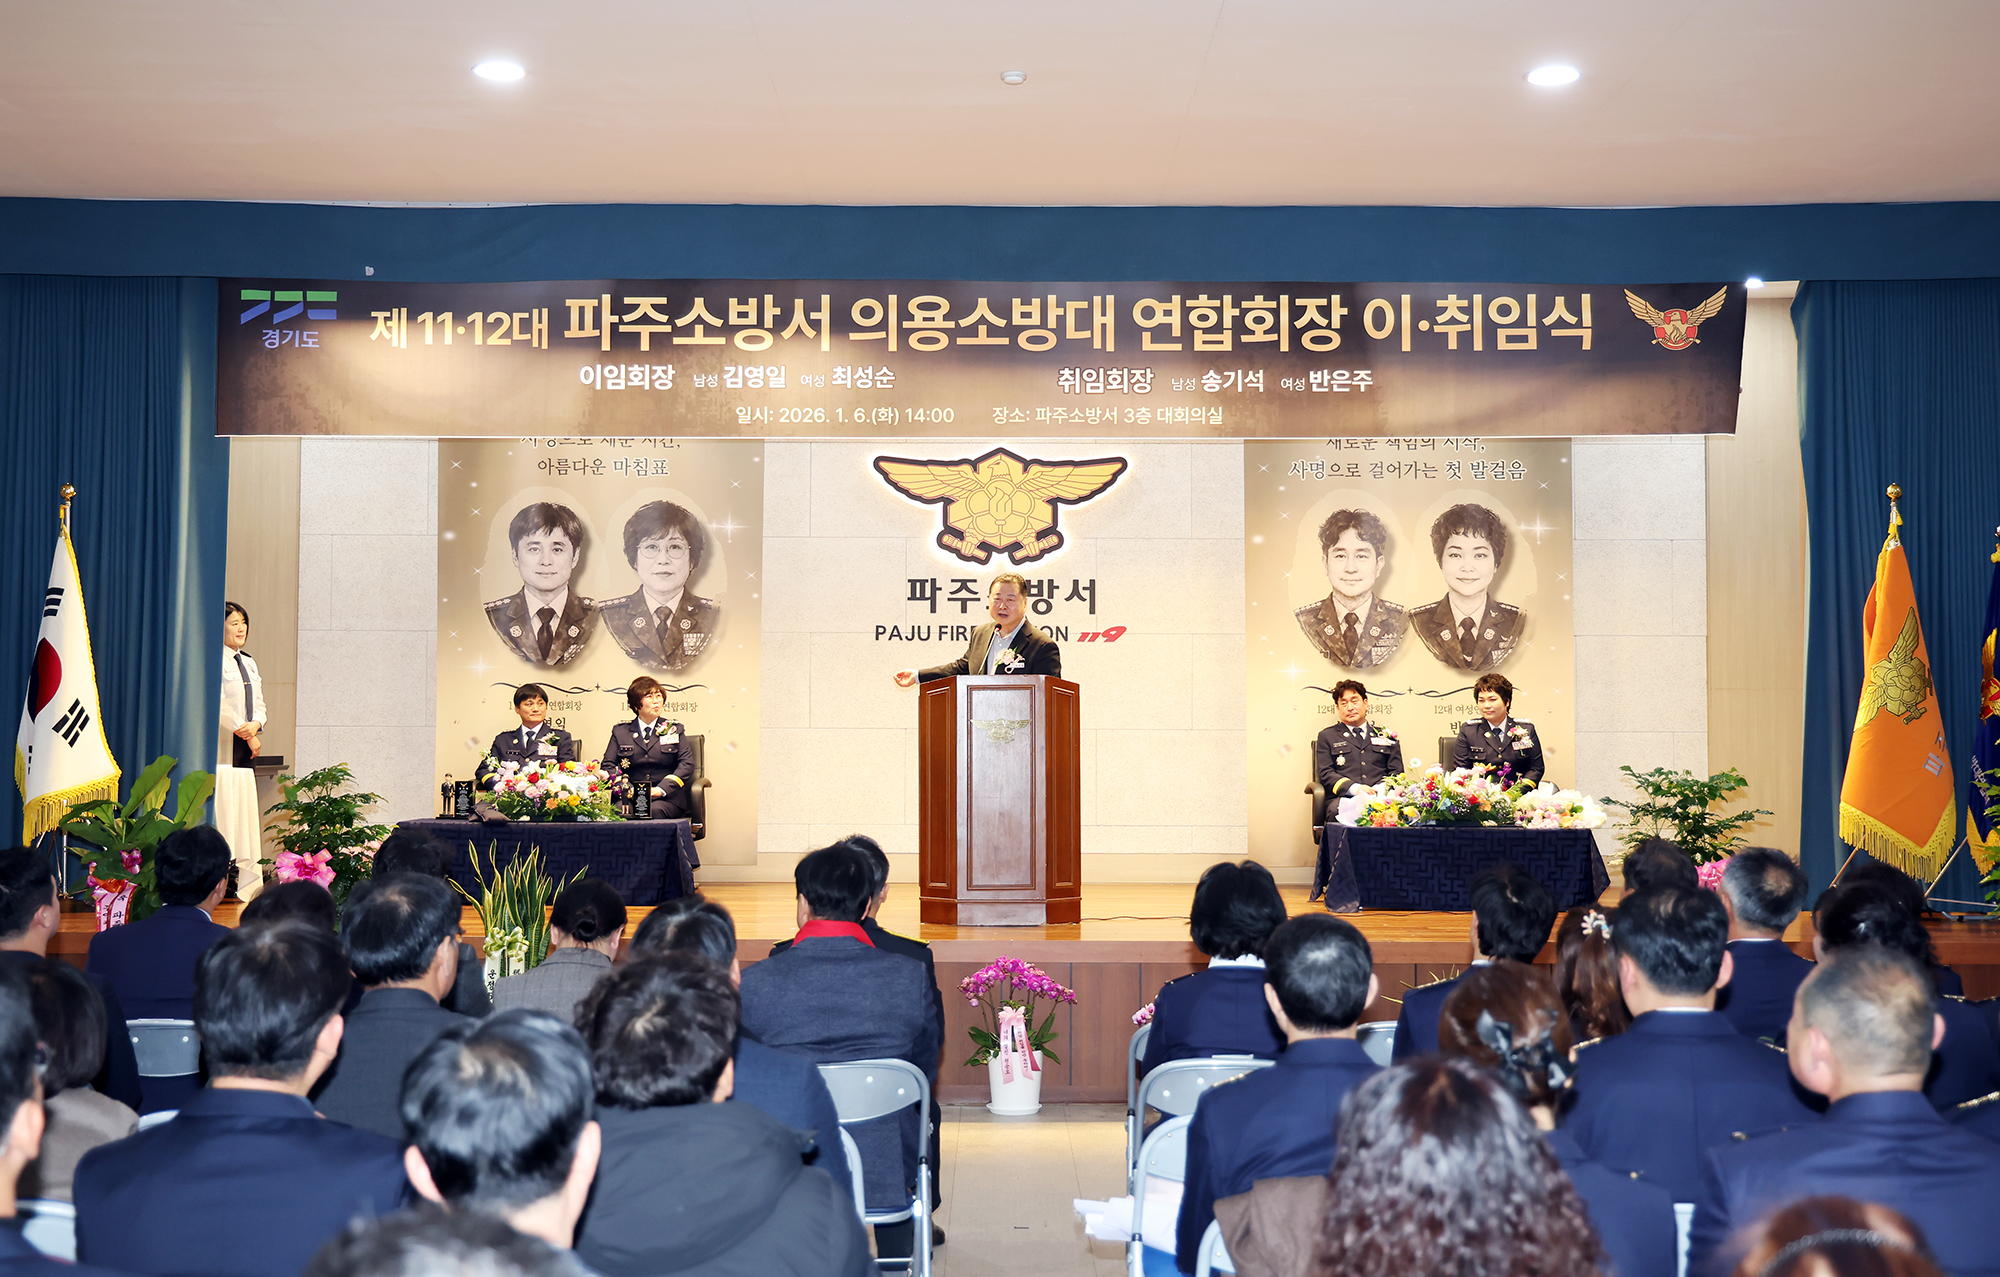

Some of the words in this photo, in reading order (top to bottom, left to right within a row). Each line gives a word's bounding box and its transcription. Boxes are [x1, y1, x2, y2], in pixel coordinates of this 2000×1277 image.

[369, 307, 408, 350] 제
[416, 307, 549, 350] 11·12대
[563, 293, 831, 352] 파주소방서
[848, 294, 1115, 352] 의용소방대
[1132, 294, 1349, 352] 연합회장
[1363, 293, 1592, 352] 이·취임식
[262, 329, 320, 348] 경기도
[579, 363, 676, 391] 이임회장
[693, 373, 718, 389] 남성
[722, 364, 787, 389] 김영일
[800, 373, 826, 389] 여성
[831, 365, 897, 389] 최성순
[1057, 367, 1156, 395] 취임회장
[1171, 377, 1196, 392] 남성
[1200, 369, 1265, 393] 송기석
[1280, 377, 1306, 392] 여성
[1309, 369, 1374, 393] 반은주
[735, 405, 774, 425] 일시:
[779, 407, 831, 424] 2026.
[835, 407, 849, 424] 1.
[904, 407, 955, 424] 14:00
[992, 406, 1031, 425] 장소:
[1034, 406, 1119, 425] 파주소방서
[1123, 406, 1152, 425] 3층
[1156, 405, 1224, 425] 대회의실
[537, 457, 606, 476] 아름다운
[612, 457, 669, 477] 마침표
[1289, 460, 1362, 480] 사명으로
[1369, 460, 1439, 480] 걸어가는
[1445, 460, 1463, 480] 첫
[1469, 460, 1527, 480] 발걸음
[907, 578, 1097, 616] 파주방서
[875, 625, 931, 642] PAJU
[1077, 626, 1128, 643] 119
[1317, 704, 1336, 715] 12대
[1434, 704, 1453, 715] 12대
